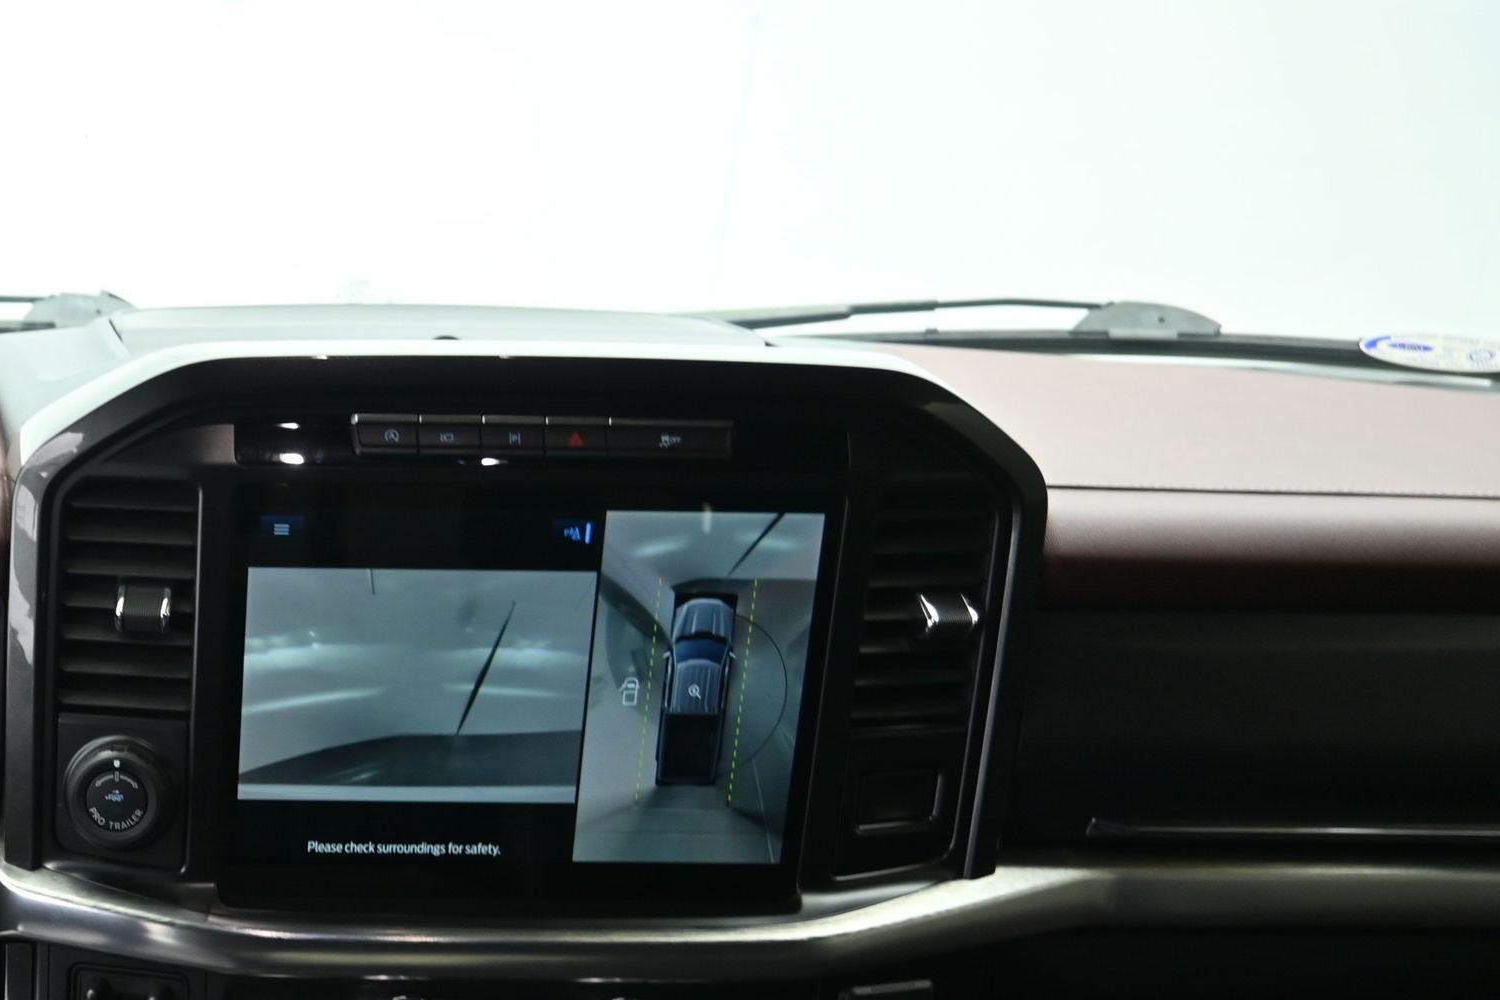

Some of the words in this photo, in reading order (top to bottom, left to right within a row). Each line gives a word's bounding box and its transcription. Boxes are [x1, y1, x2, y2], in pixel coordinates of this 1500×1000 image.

[89, 807, 106, 826] PRO
[109, 808, 144, 830] TRAILER
[307, 841, 343, 853] Please
[344, 841, 375, 854] check
[376, 841, 447, 856] surroundings
[448, 842, 464, 855] for
[465, 842, 501, 856] safety.
